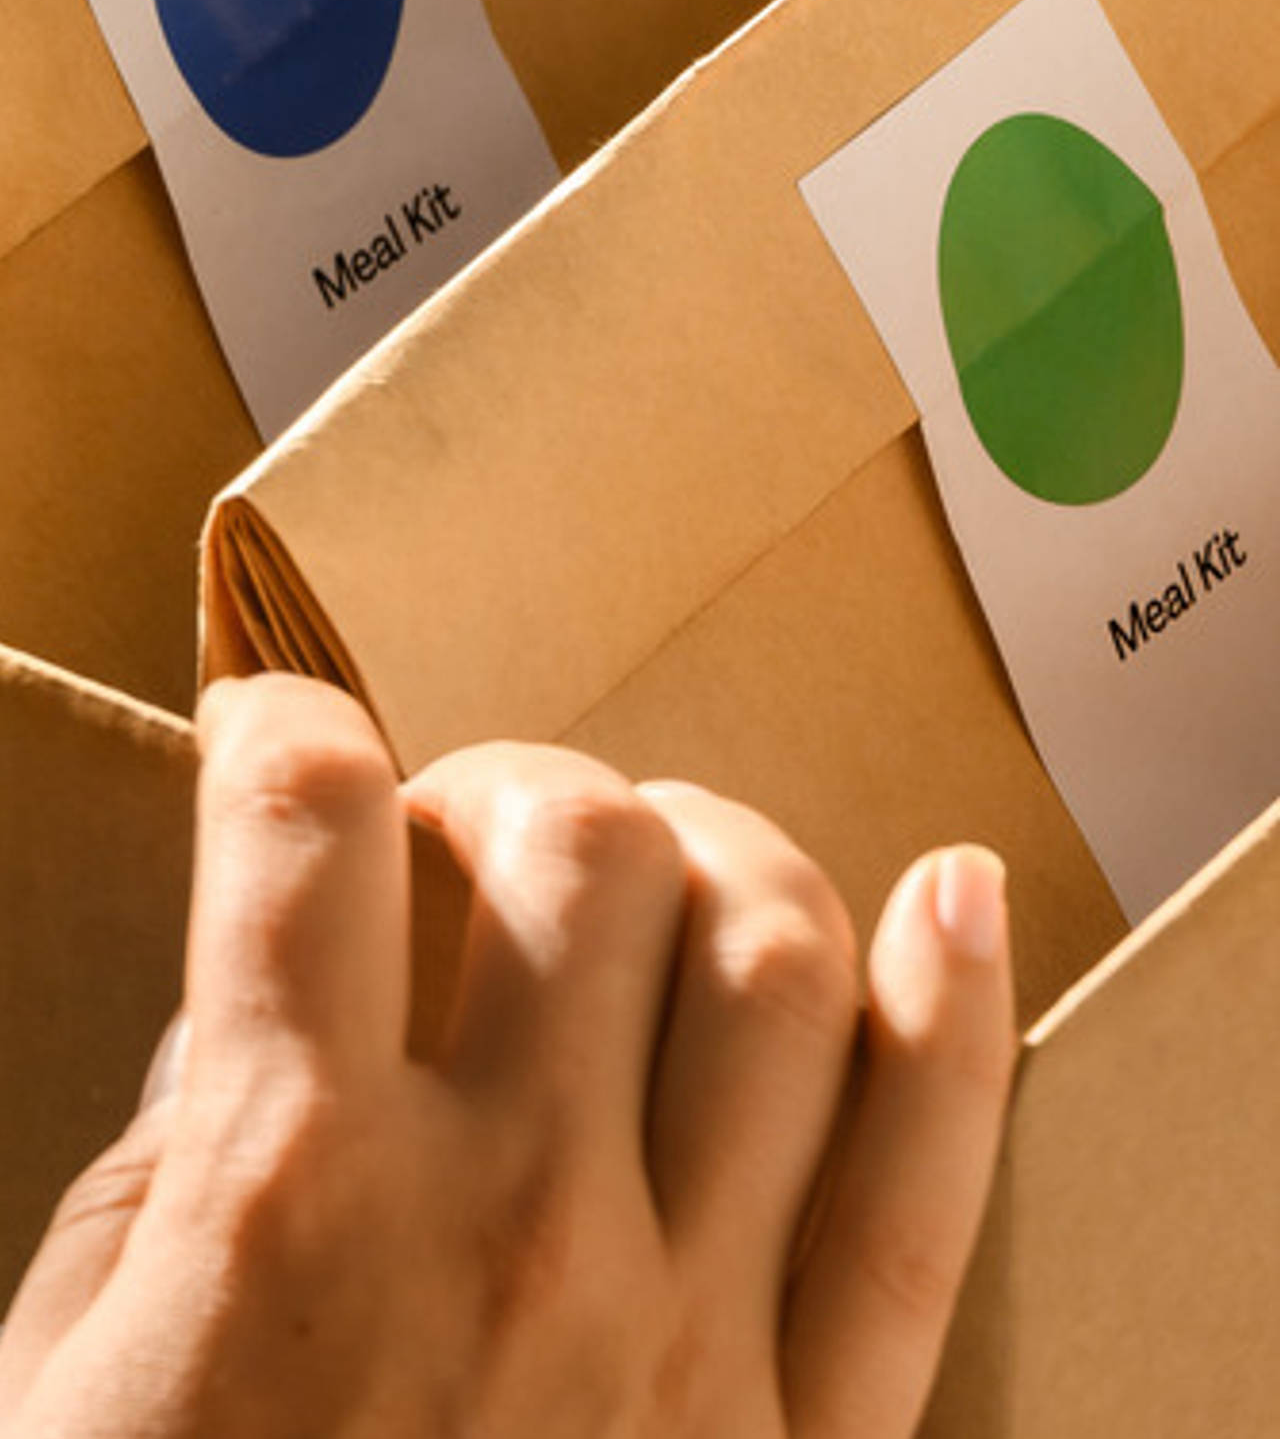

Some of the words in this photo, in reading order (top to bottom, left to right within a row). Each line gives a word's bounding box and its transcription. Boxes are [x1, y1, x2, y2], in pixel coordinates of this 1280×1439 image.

[311, 213, 408, 309] Meal
[401, 183, 462, 244] Kit
[1108, 561, 1197, 661] Meal
[1192, 528, 1248, 592] Kit
